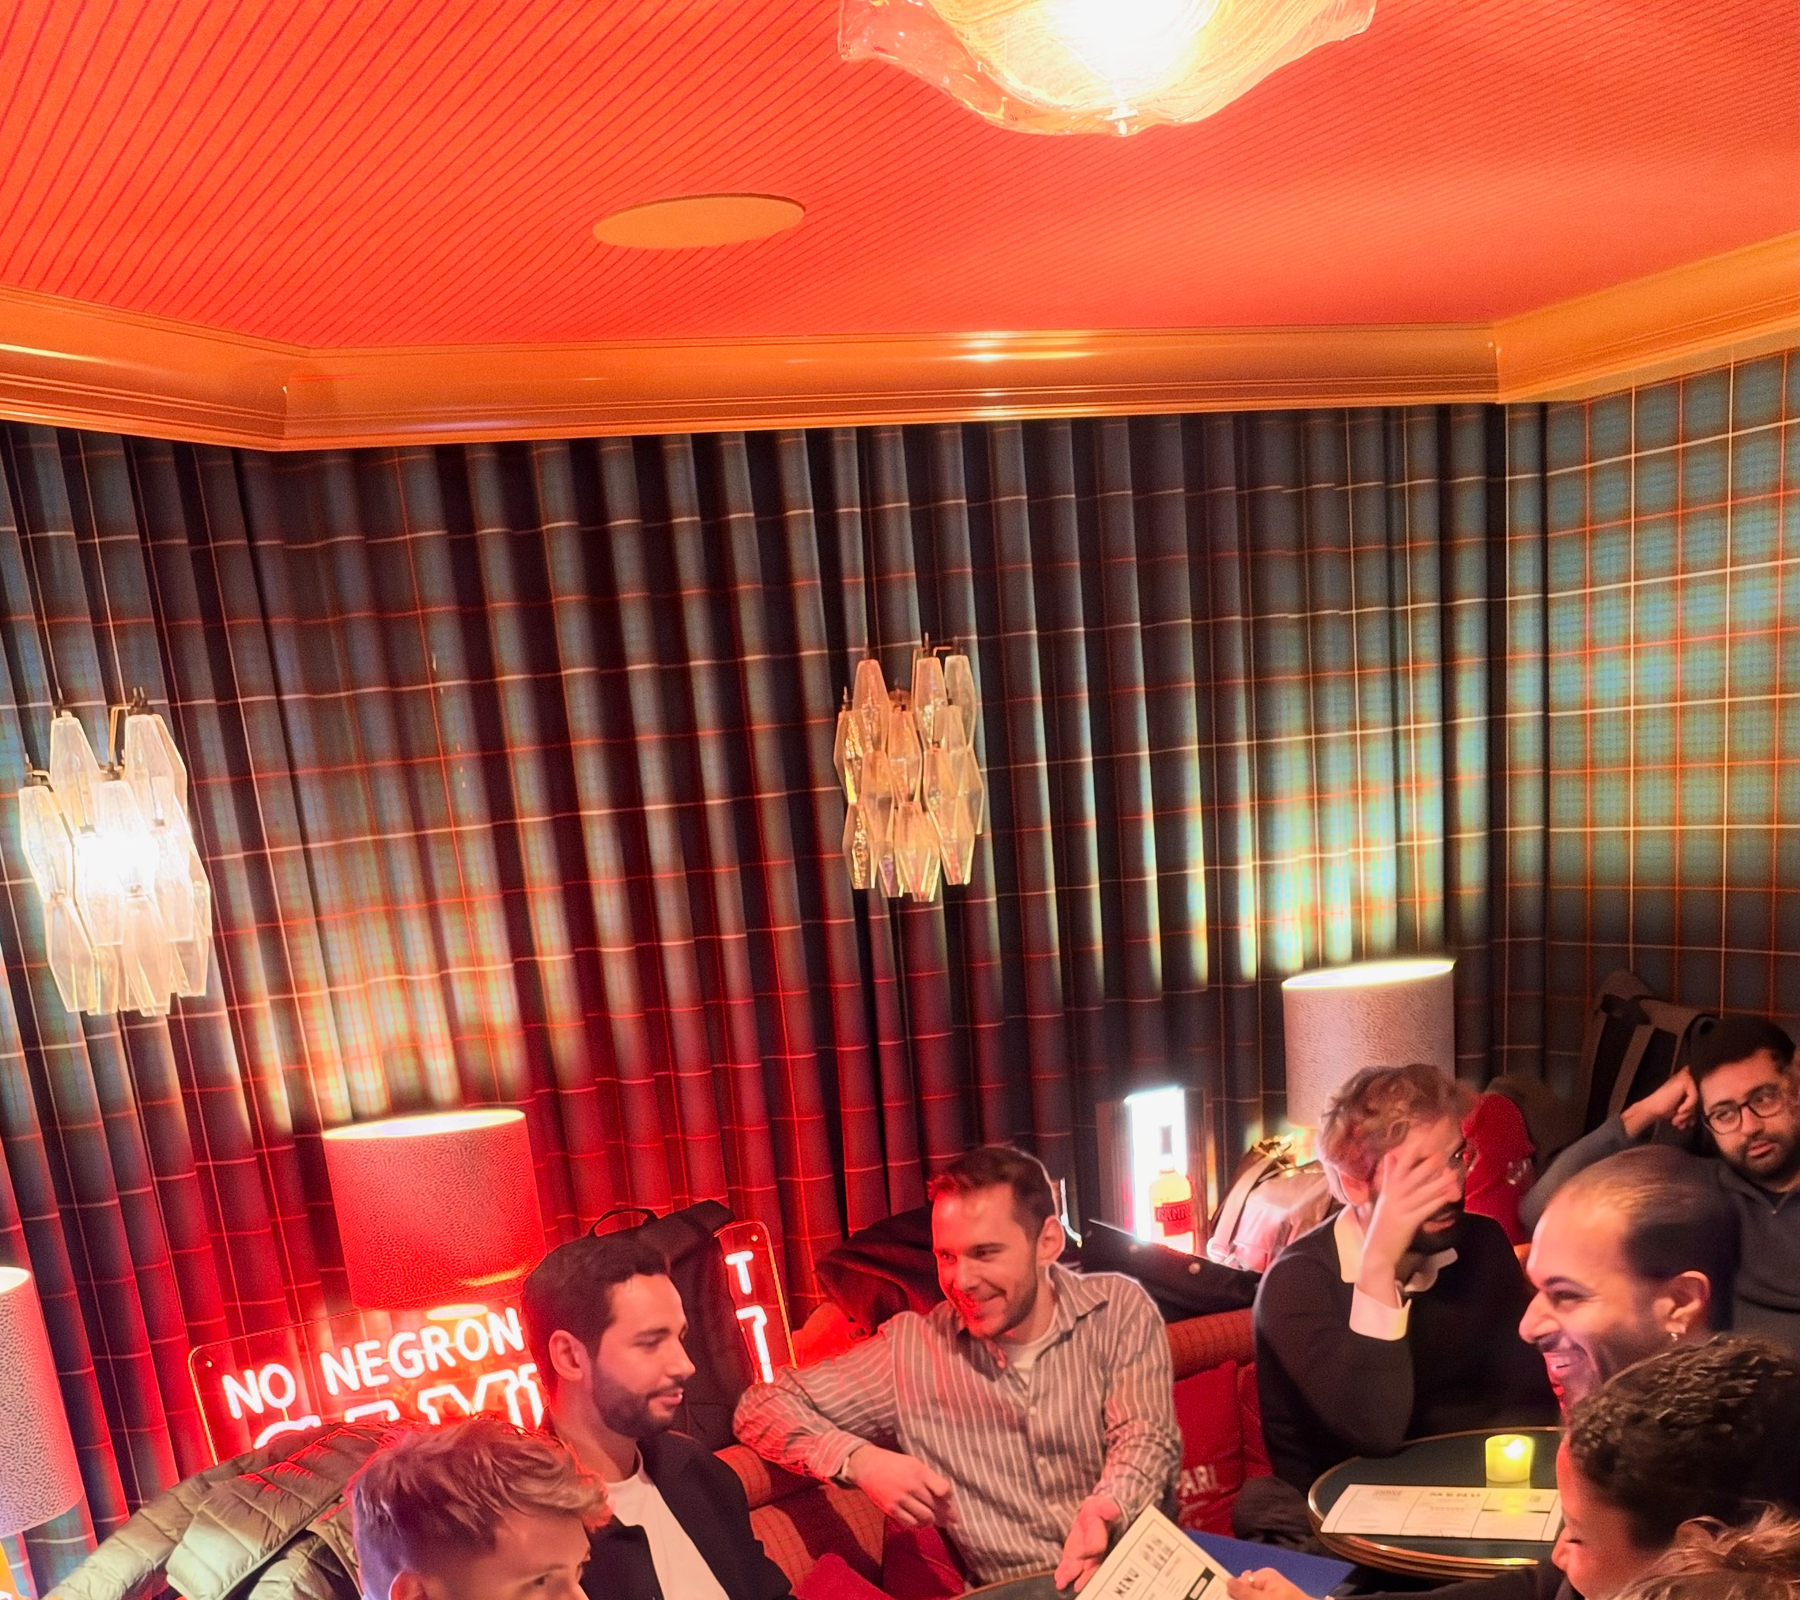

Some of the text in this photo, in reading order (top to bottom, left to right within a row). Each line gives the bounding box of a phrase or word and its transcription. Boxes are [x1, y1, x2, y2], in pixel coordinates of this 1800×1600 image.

[222, 1307, 526, 1420] NO NEGRON
[1114, 1564, 1141, 1600] MENU
